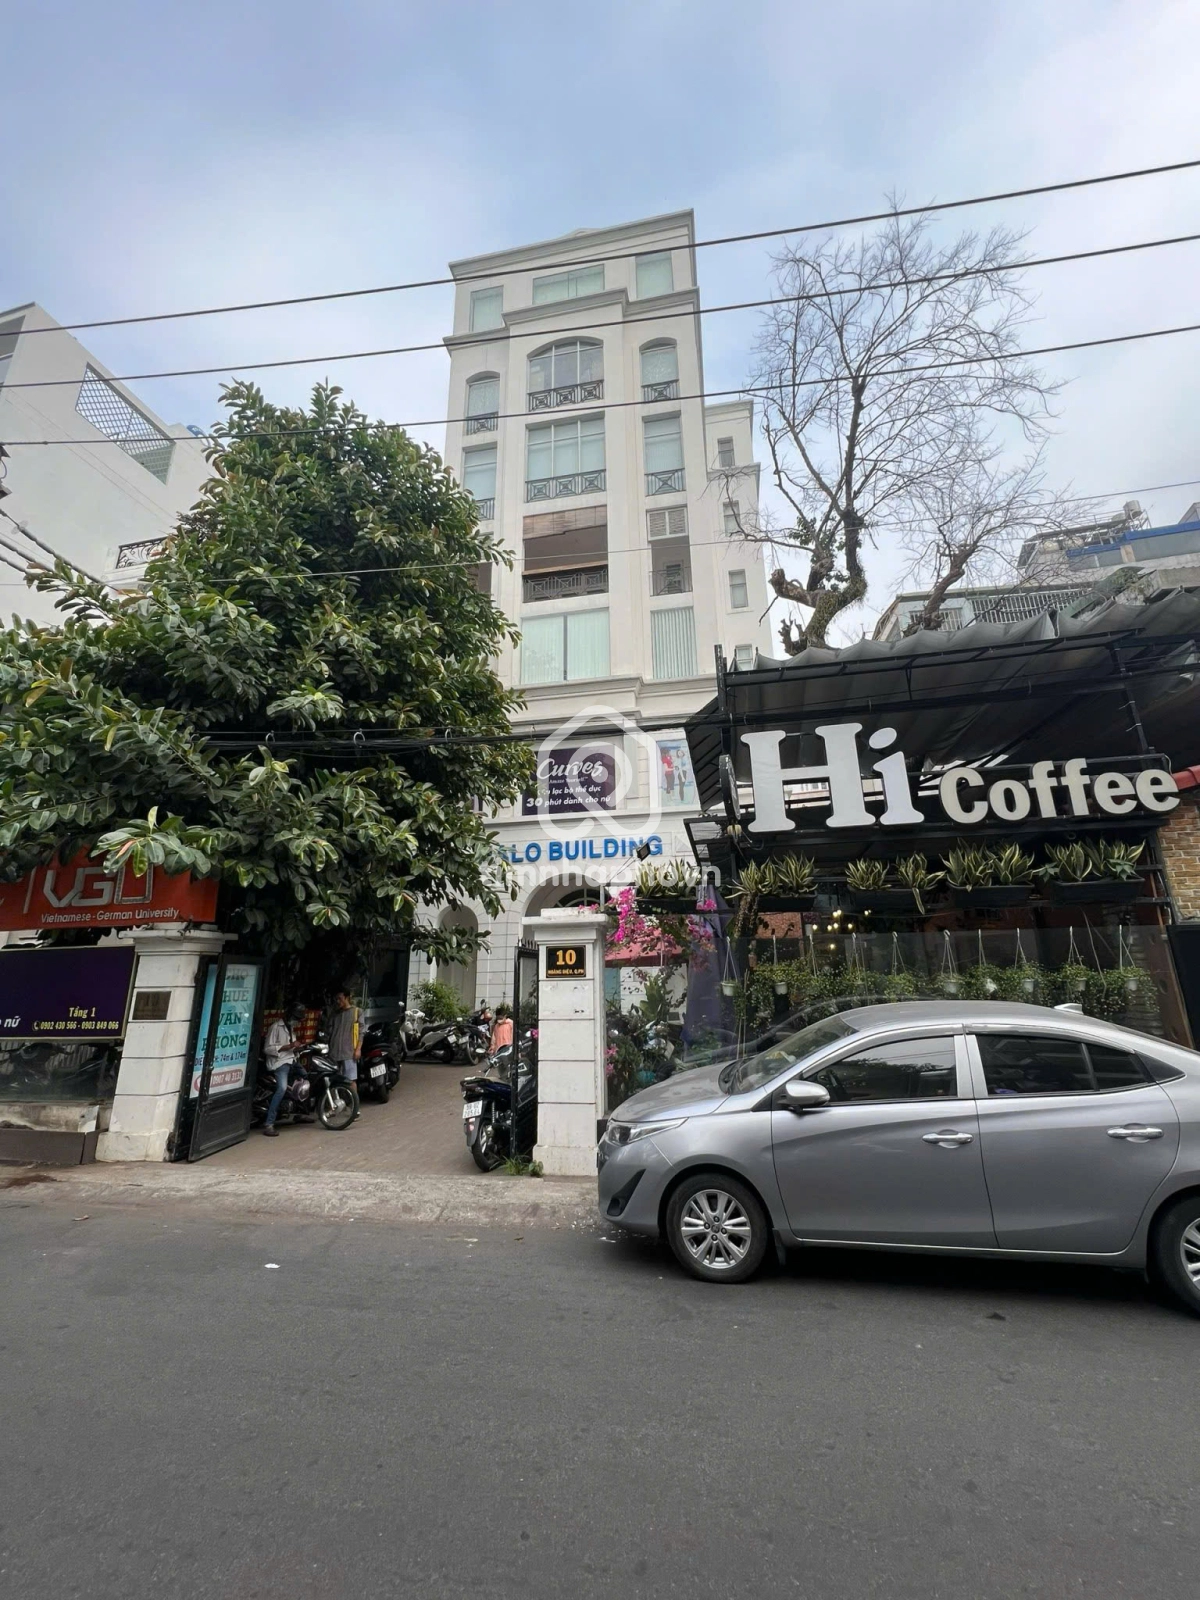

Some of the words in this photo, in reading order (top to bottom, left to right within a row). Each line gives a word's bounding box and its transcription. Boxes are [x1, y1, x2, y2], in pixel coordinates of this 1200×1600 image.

[536, 758, 603, 779] Curves
[740, 722, 925, 833] Hi
[938, 757, 1181, 824] Coffee
[526, 797, 543, 808] 30
[585, 796, 599, 804] cho
[549, 834, 663, 861] BUILDING
[43, 863, 153, 908] VGU
[97, 910, 132, 921] German
[135, 907, 179, 919] University
[556, 949, 577, 966] 10
[91, 1007, 96, 1017] 1
